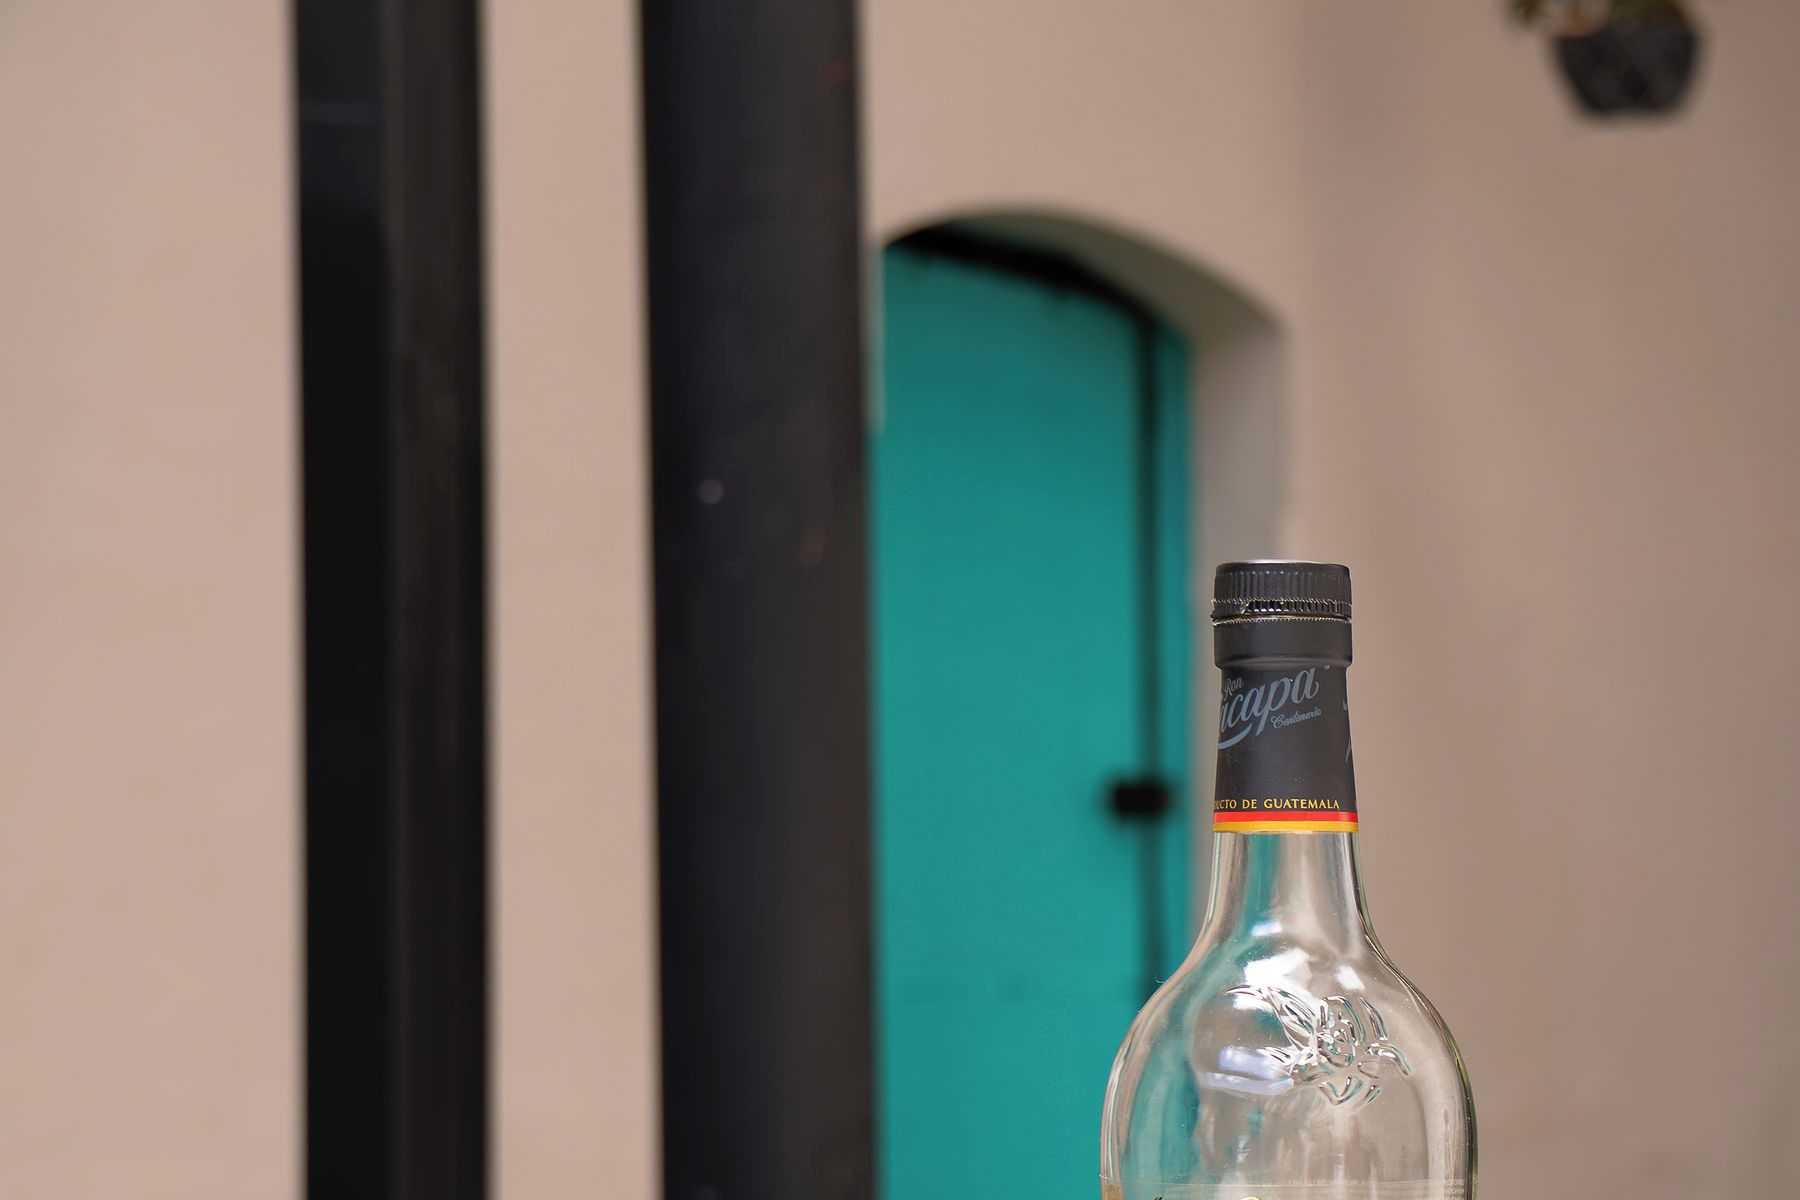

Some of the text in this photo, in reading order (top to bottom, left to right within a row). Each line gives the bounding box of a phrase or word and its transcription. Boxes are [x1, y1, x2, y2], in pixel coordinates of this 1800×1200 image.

[1225, 676, 1243, 696] Ron
[1218, 667, 1319, 749] acapa
[1271, 706, 1322, 729] Centenario
[1214, 798, 1340, 811] UCTO DE GUATEMALA
